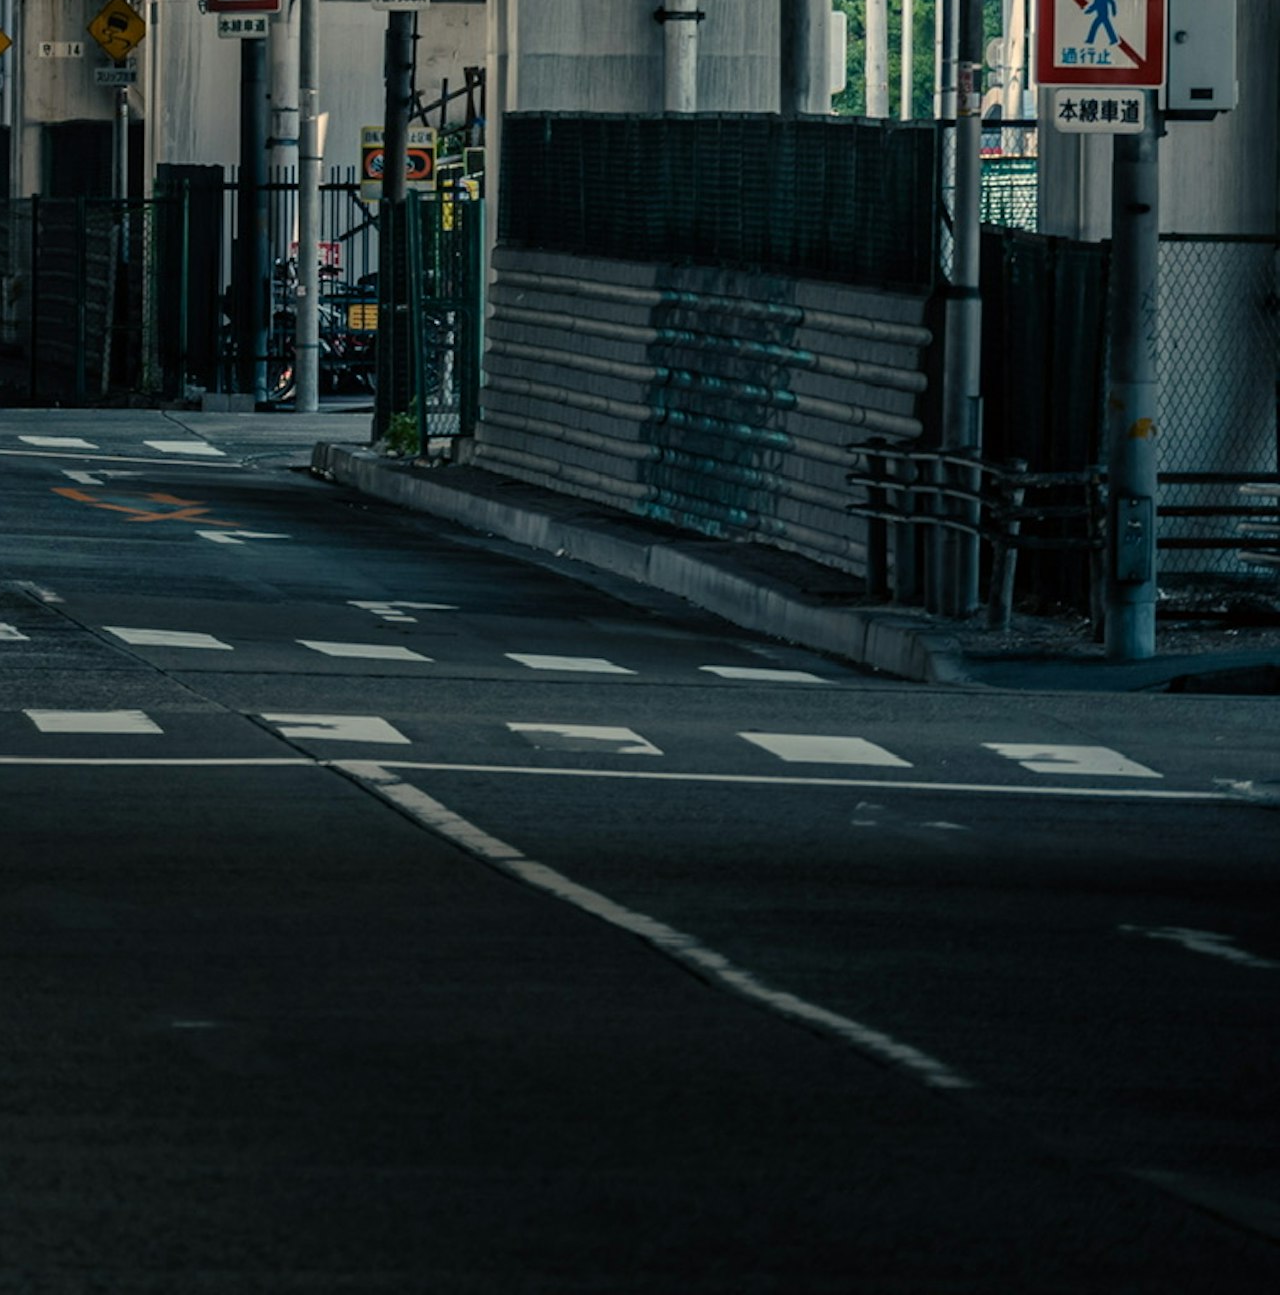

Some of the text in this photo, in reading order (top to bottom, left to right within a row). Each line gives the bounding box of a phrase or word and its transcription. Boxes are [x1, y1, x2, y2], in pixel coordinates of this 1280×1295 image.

[1062, 49, 1111, 64] 通行止
[1059, 99, 1139, 124] 本線車道
